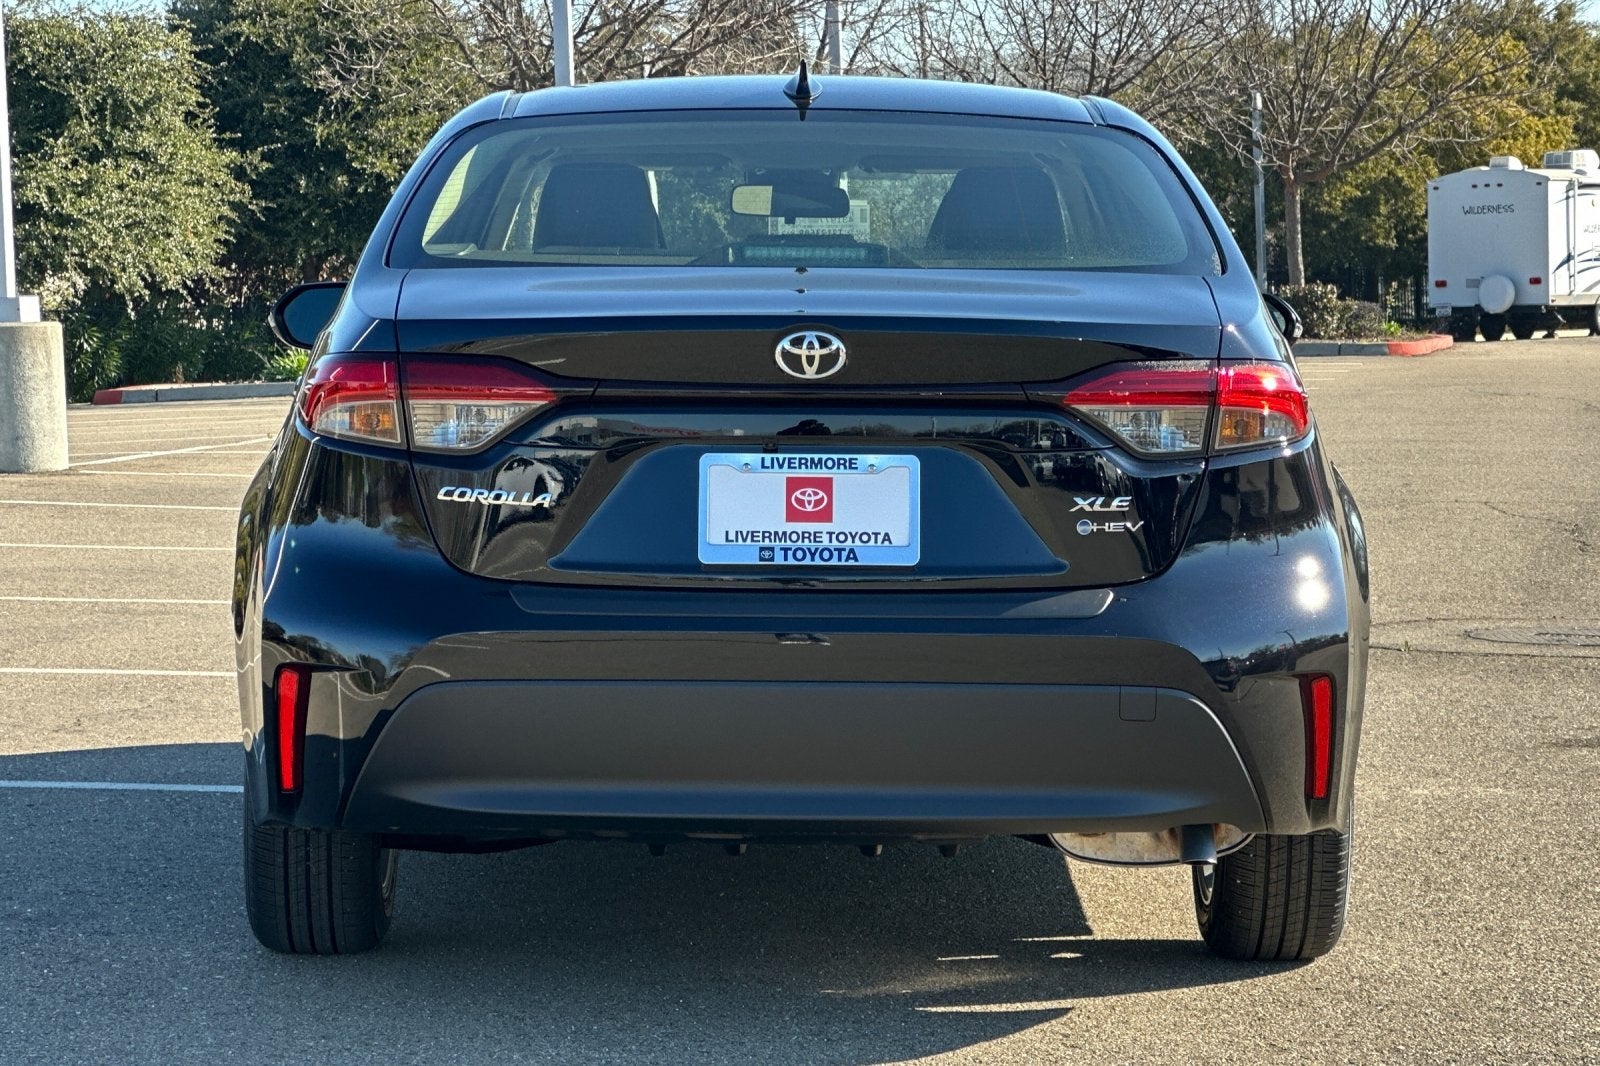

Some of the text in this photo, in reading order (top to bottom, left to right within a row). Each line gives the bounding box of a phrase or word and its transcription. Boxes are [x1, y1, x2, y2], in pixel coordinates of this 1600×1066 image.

[1462, 204, 1515, 215] WILDERNESS
[760, 456, 859, 470] LIVERMORE
[437, 486, 552, 508] COROLLA
[1068, 496, 1132, 512] XLE
[1092, 520, 1144, 532] HEV
[724, 530, 893, 545] LIVERMORE TOYOTA
[780, 547, 859, 563] TOYOTA
